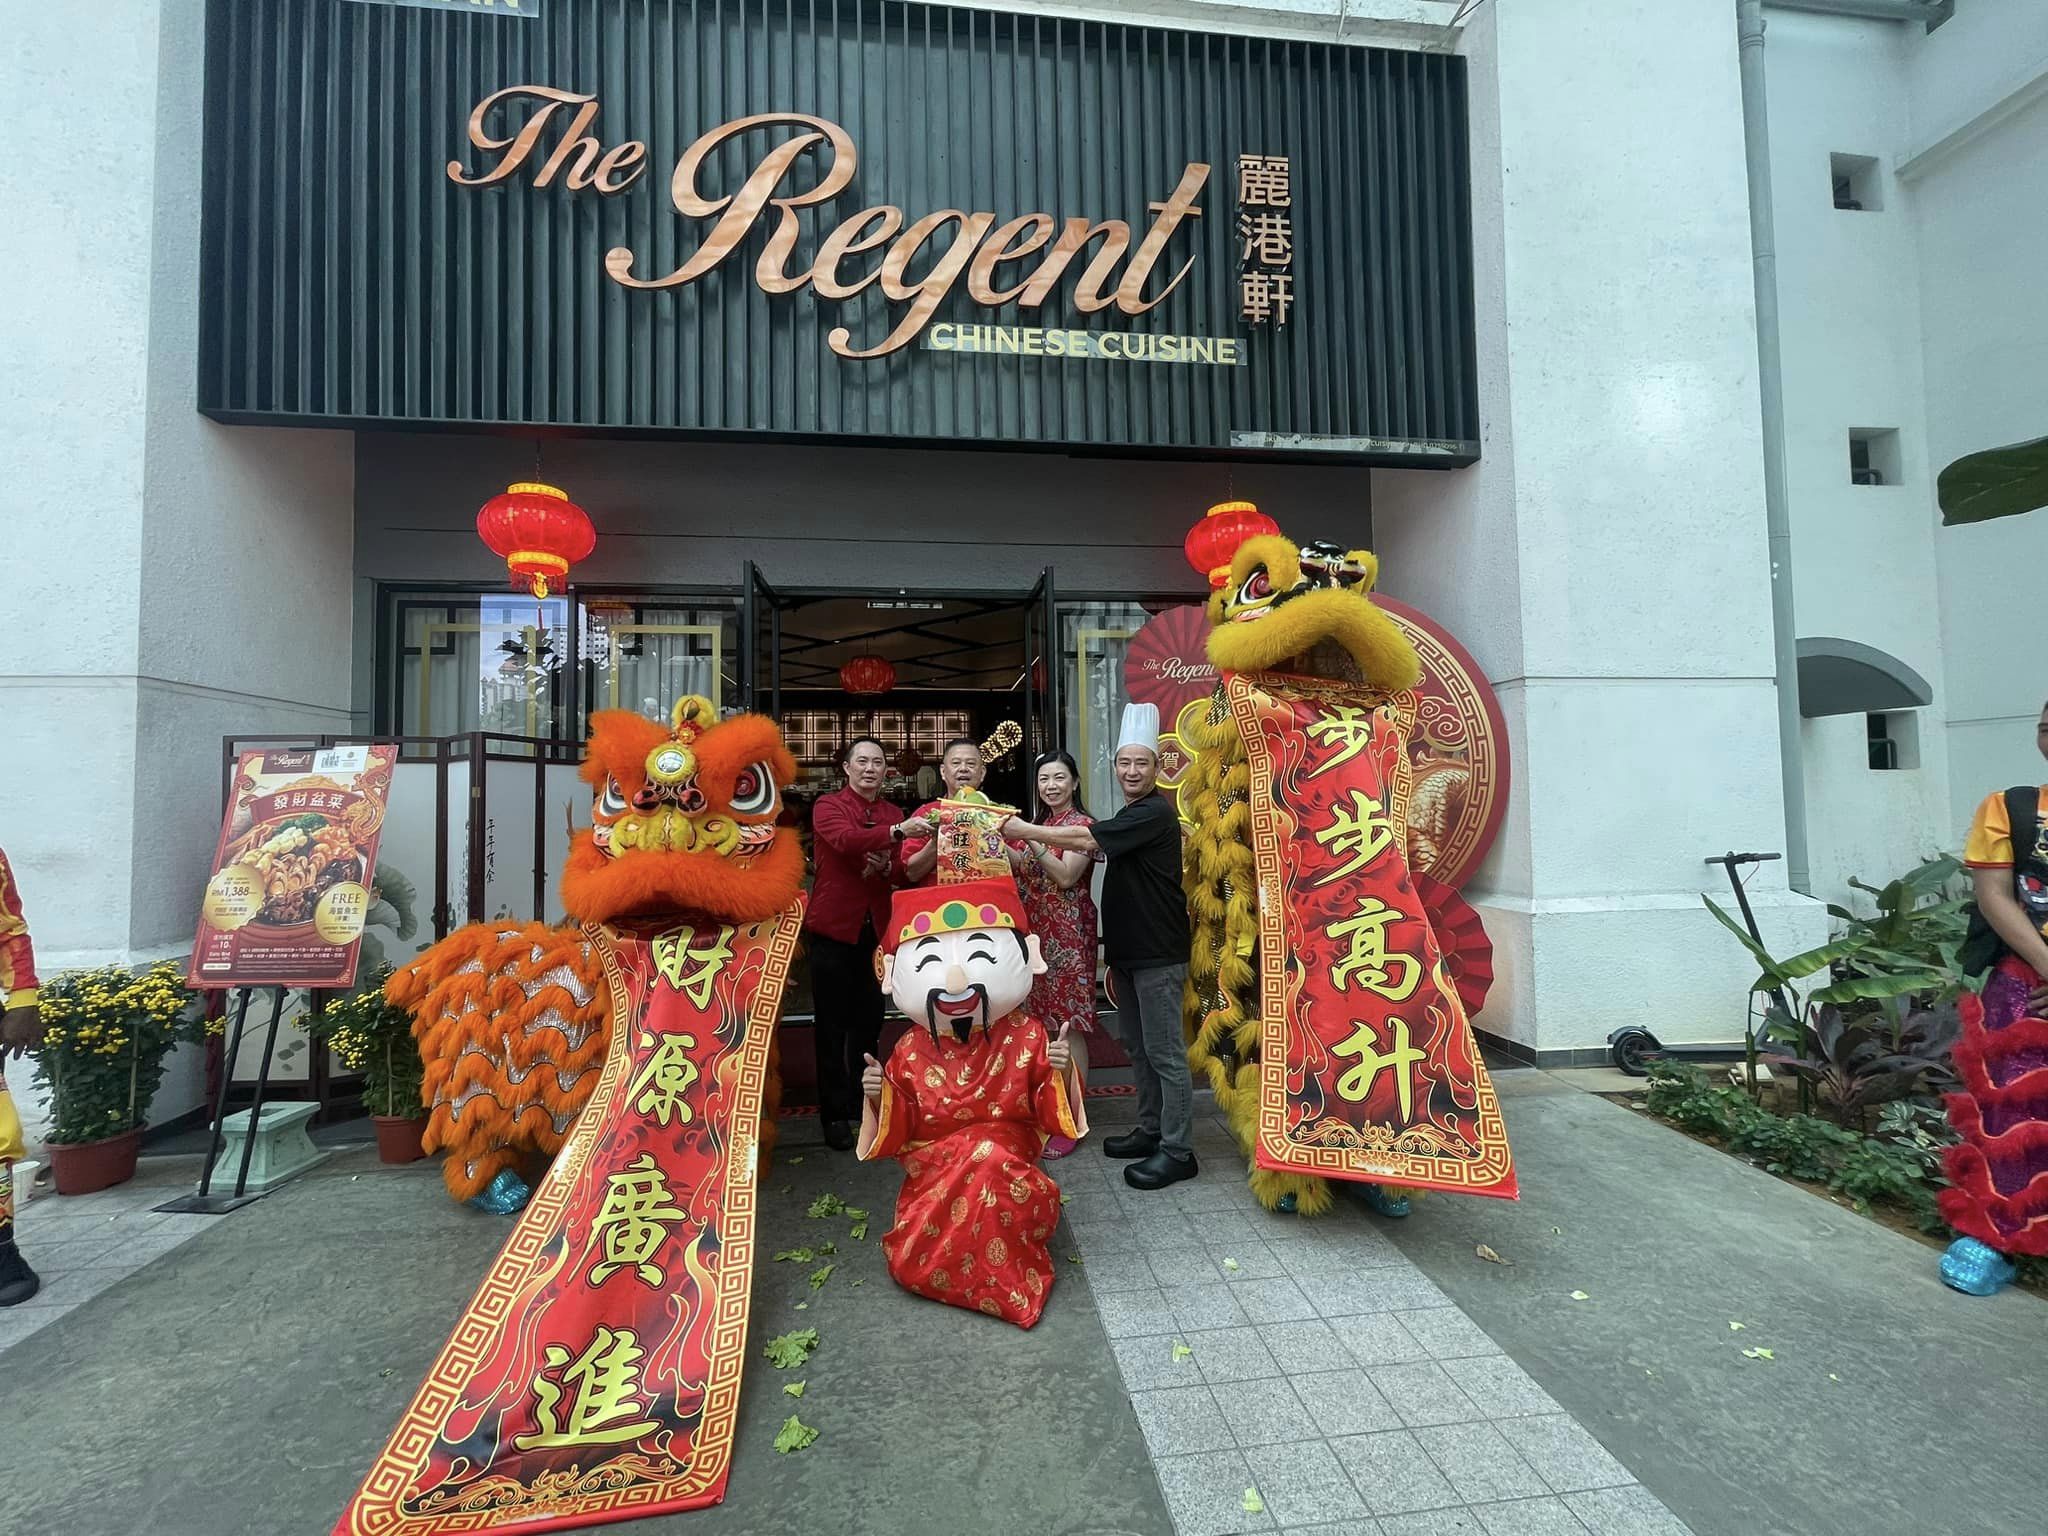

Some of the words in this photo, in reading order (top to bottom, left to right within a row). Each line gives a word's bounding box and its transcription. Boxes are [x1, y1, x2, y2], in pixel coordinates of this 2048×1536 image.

[447, 85, 647, 193] The
[605, 112, 1211, 358] Regent
[1238, 154, 1293, 327] 麗港軒
[930, 323, 1088, 357] CHINESE
[1098, 332, 1236, 363] CUISINE
[1142, 659, 1160, 671] The
[332, 893, 361, 904] FREE
[1307, 706, 1426, 1123] 步步高升
[516, 925, 733, 1449] 財源廣進
